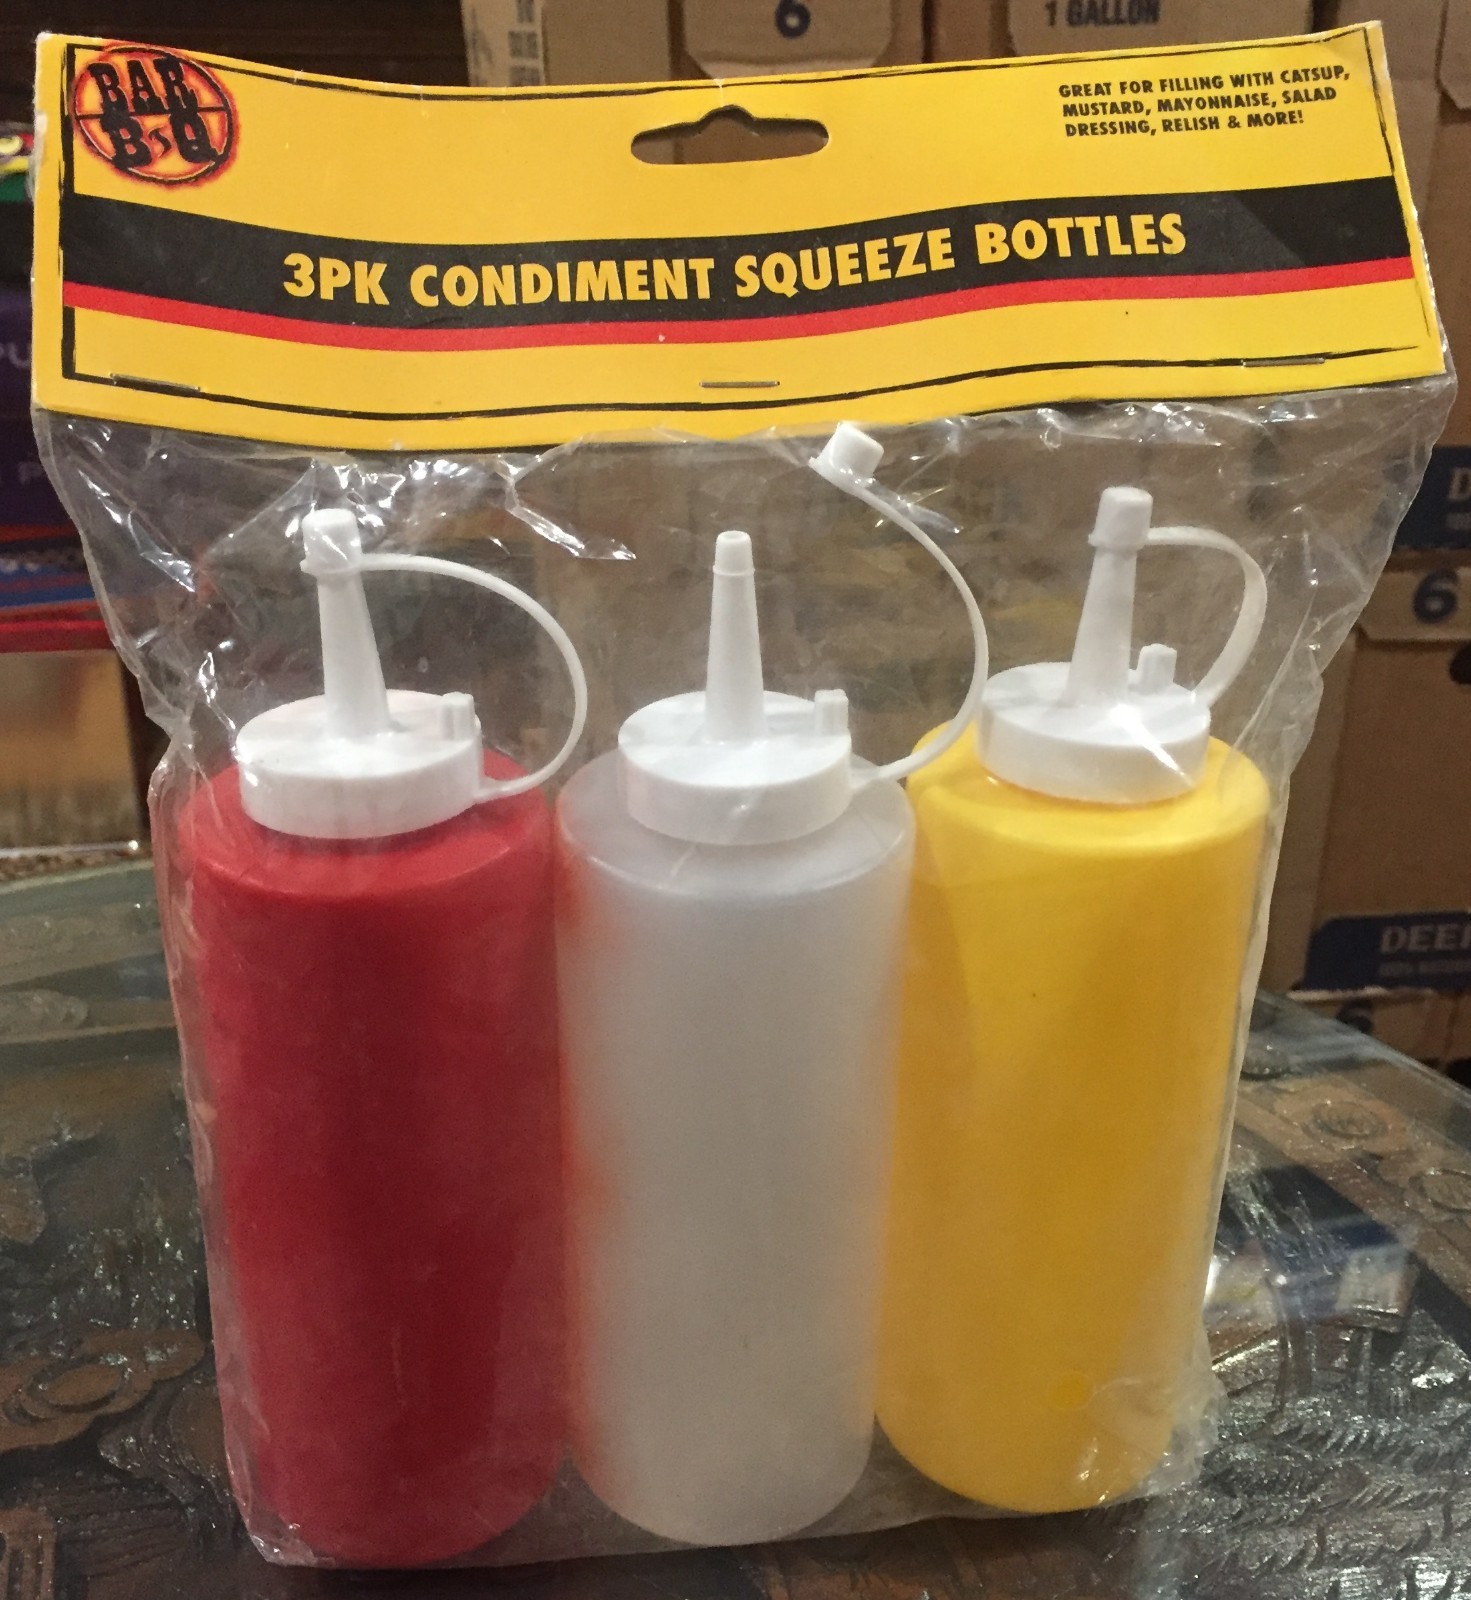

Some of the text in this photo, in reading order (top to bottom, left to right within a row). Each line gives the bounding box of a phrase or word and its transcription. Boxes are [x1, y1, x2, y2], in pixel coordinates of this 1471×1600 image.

[1044, 0, 1160, 27] 1 GALLON
[87, 56, 198, 116] BAR
[1058, 65, 1350, 98] GREAT FOR FILLING WITH CATSUP,
[1062, 86, 1337, 117] MUSTARD, MAYONNAISE, SALAD
[1065, 110, 1304, 137] DRESSING, RELISH & MORE!
[283, 213, 1187, 308] 3PK CONDIMENT SQUEEZE BOTTLES
[1414, 568, 1460, 624] 6
